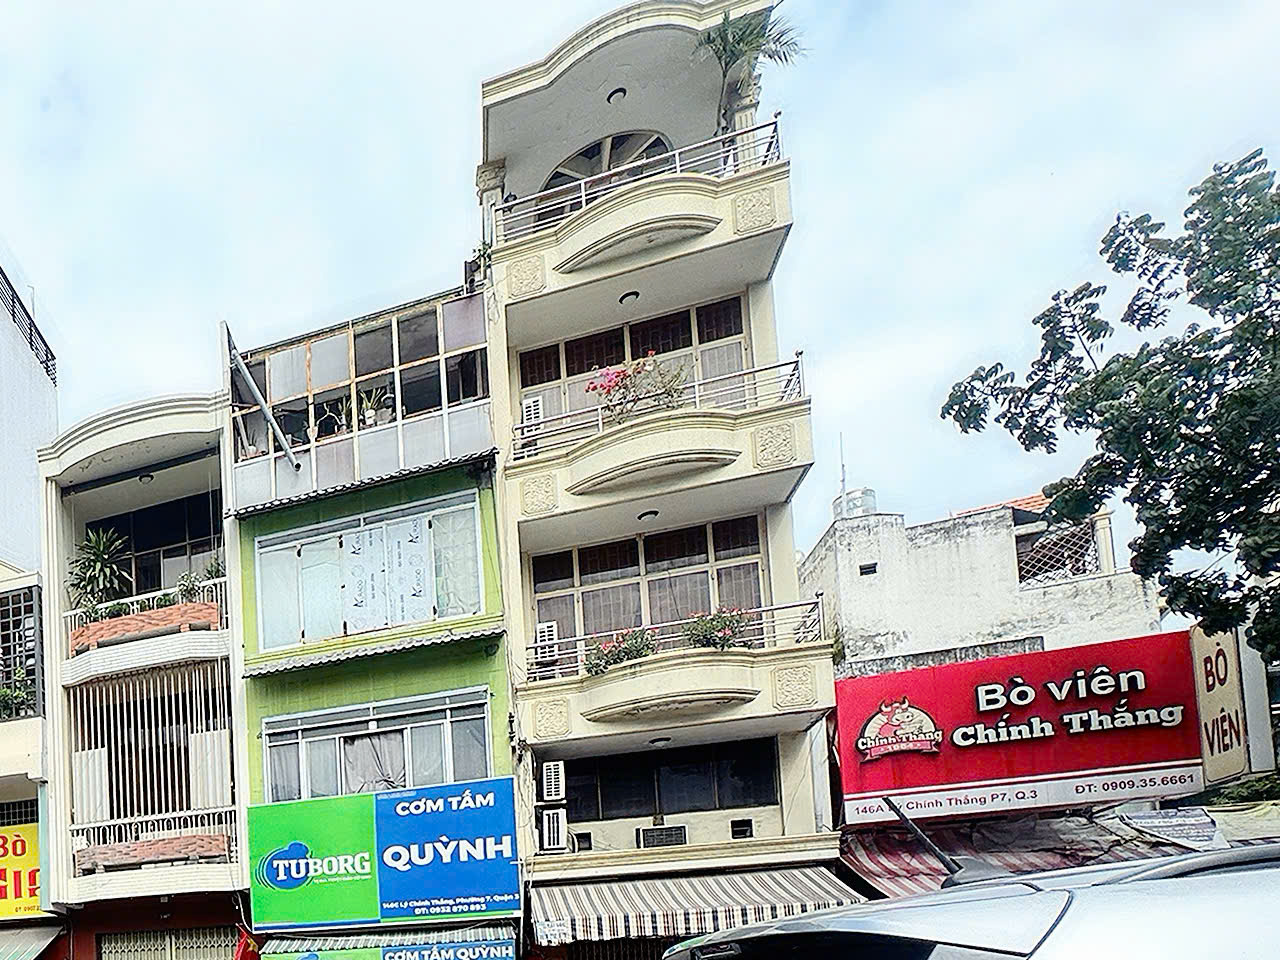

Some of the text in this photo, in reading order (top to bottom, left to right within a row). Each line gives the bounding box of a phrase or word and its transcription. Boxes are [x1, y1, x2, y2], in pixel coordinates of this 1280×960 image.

[976, 665, 1147, 713] Bò viên
[951, 698, 1185, 748] Chính Thắng
[1203, 707, 1242, 757] VIÊN
[1074, 773, 1195, 795] ĐT: 0909.35.6661
[395, 788, 495, 817] CƠM TẤM
[855, 805, 885, 816] 146A
[906, 797, 943, 811] Chính
[946, 793, 987, 807] Thắng
[991, 792, 1011, 804] P7,
[1015, 790, 1039, 800] Q.3
[272, 851, 372, 881] TUBORG
[382, 834, 513, 872] QUỲNH
